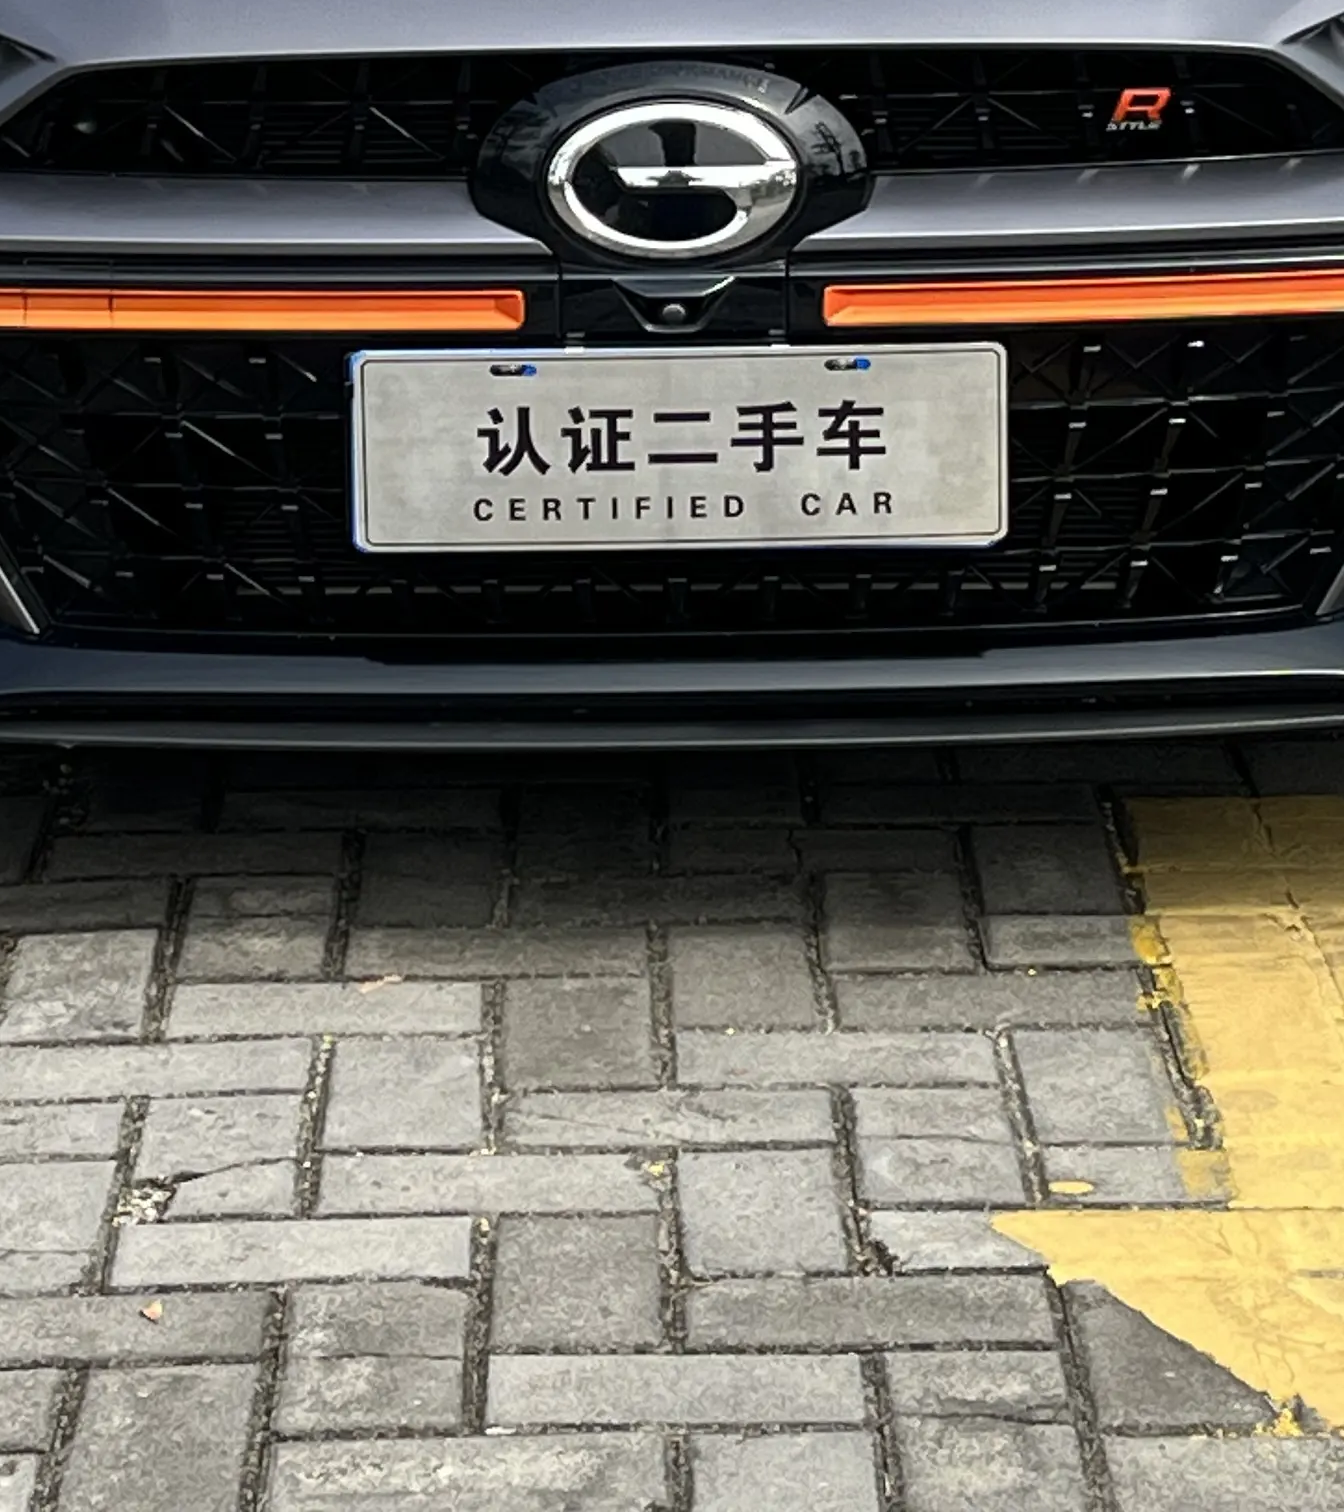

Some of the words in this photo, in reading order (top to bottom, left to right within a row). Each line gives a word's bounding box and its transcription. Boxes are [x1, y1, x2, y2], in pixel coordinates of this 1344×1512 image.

[478, 400, 885, 475] 认证二手车
[474, 496, 744, 521] CERTIFIED
[802, 492, 892, 515] CAR
